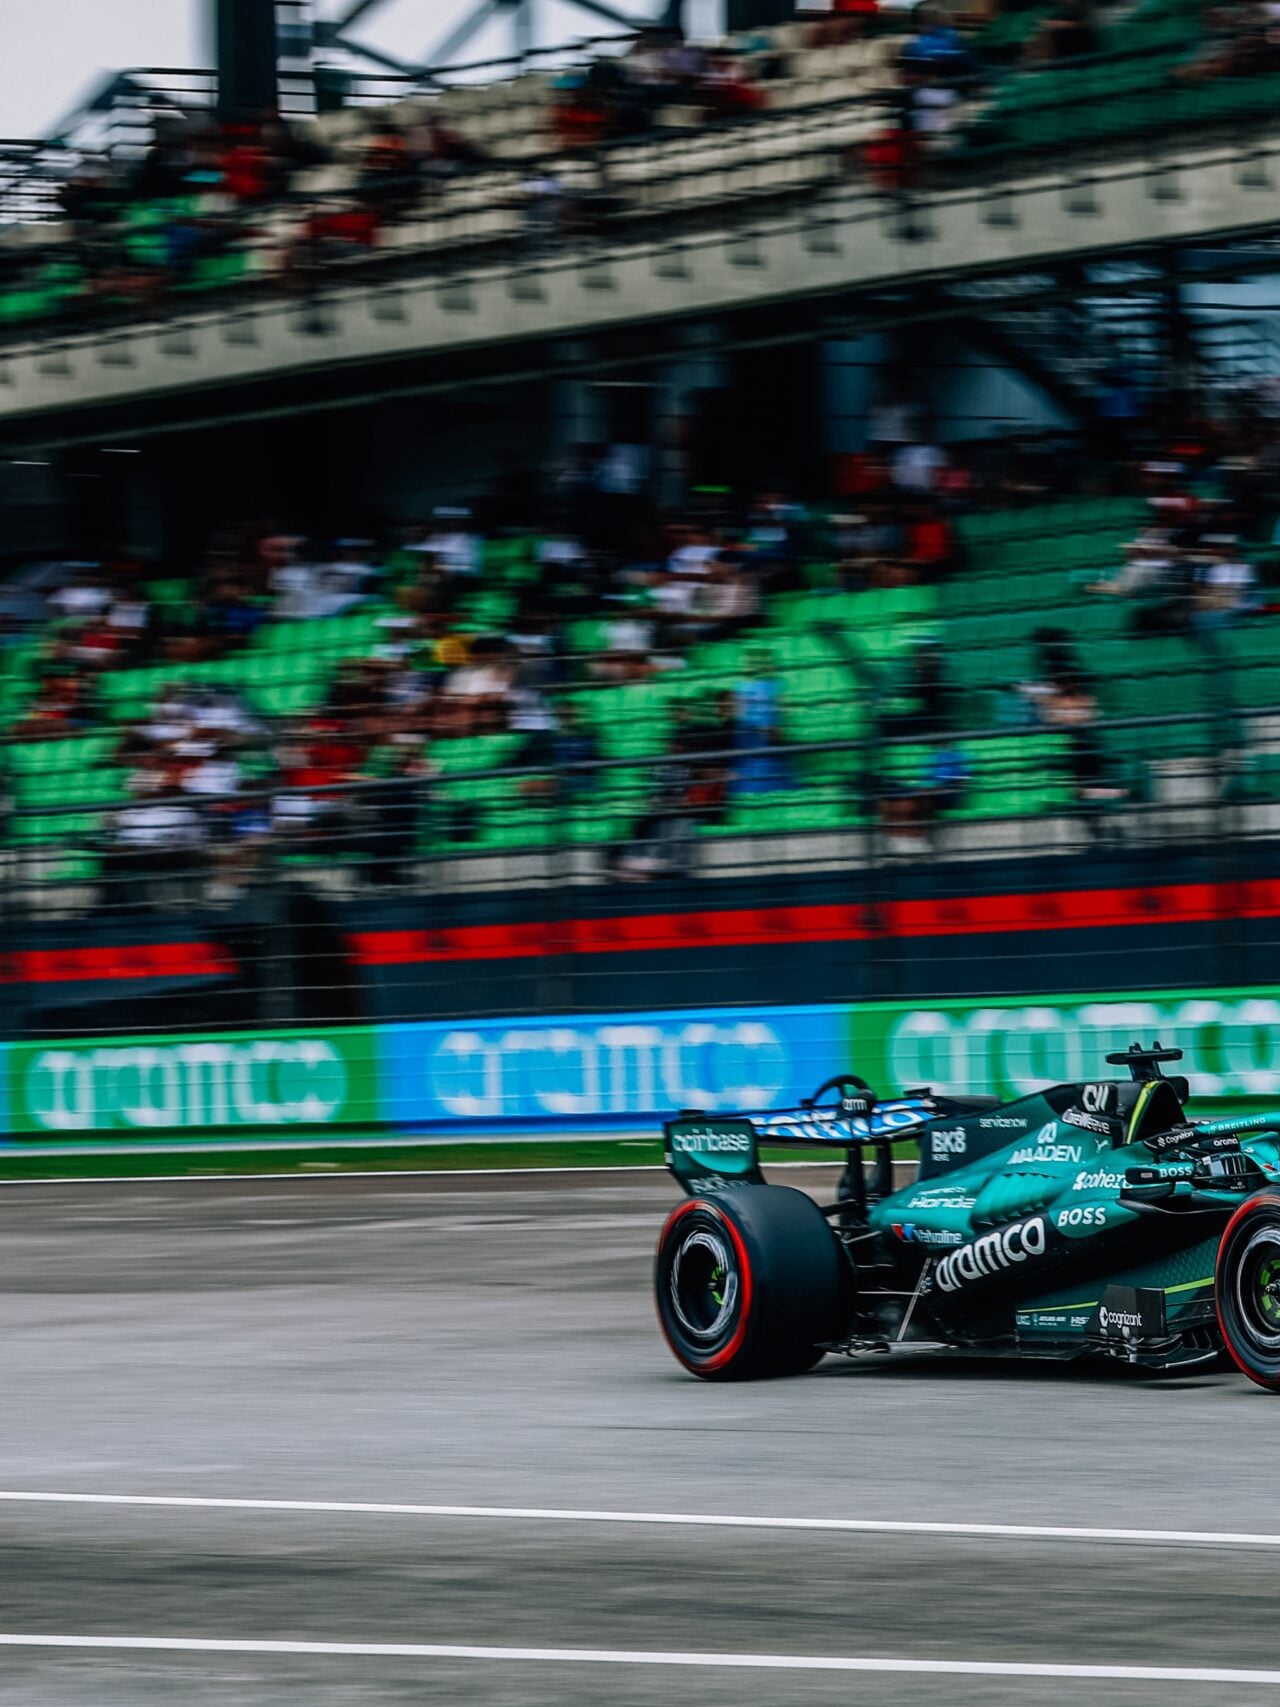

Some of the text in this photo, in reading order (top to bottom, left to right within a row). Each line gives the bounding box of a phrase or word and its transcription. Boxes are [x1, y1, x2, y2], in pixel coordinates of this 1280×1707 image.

[1218, 1117, 1266, 1130] BREITLING
[672, 1127, 750, 1152] coinbase
[932, 1127, 966, 1153] BK8
[1165, 1129, 1194, 1145] Cognition
[1160, 1166, 1192, 1178] BOSS
[907, 1195, 977, 1209] Honda
[1057, 1207, 1107, 1227] BOSS
[936, 1217, 1046, 1292] aramco
[1108, 1310, 1143, 1328] cognizant
